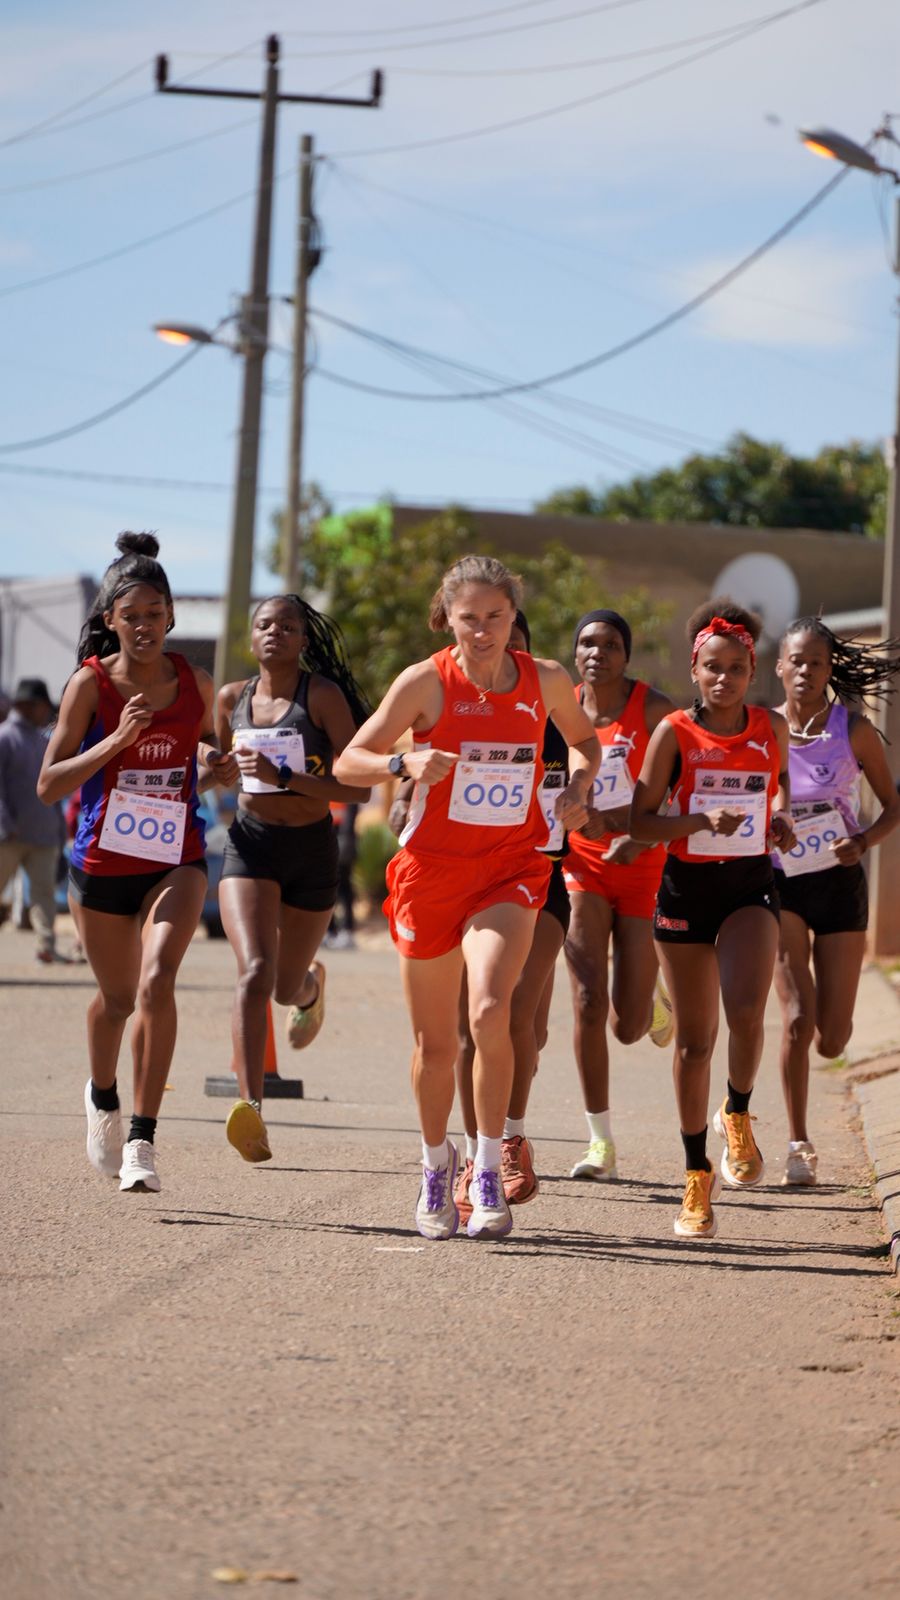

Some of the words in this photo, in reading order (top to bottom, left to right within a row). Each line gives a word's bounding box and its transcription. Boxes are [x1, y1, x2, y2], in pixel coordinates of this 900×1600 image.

[486, 749, 509, 761] 2026
[144, 774, 163, 786] 2026
[721, 776, 741, 789] 2026
[463, 783, 524, 808] 005
[114, 812, 177, 845] 008
